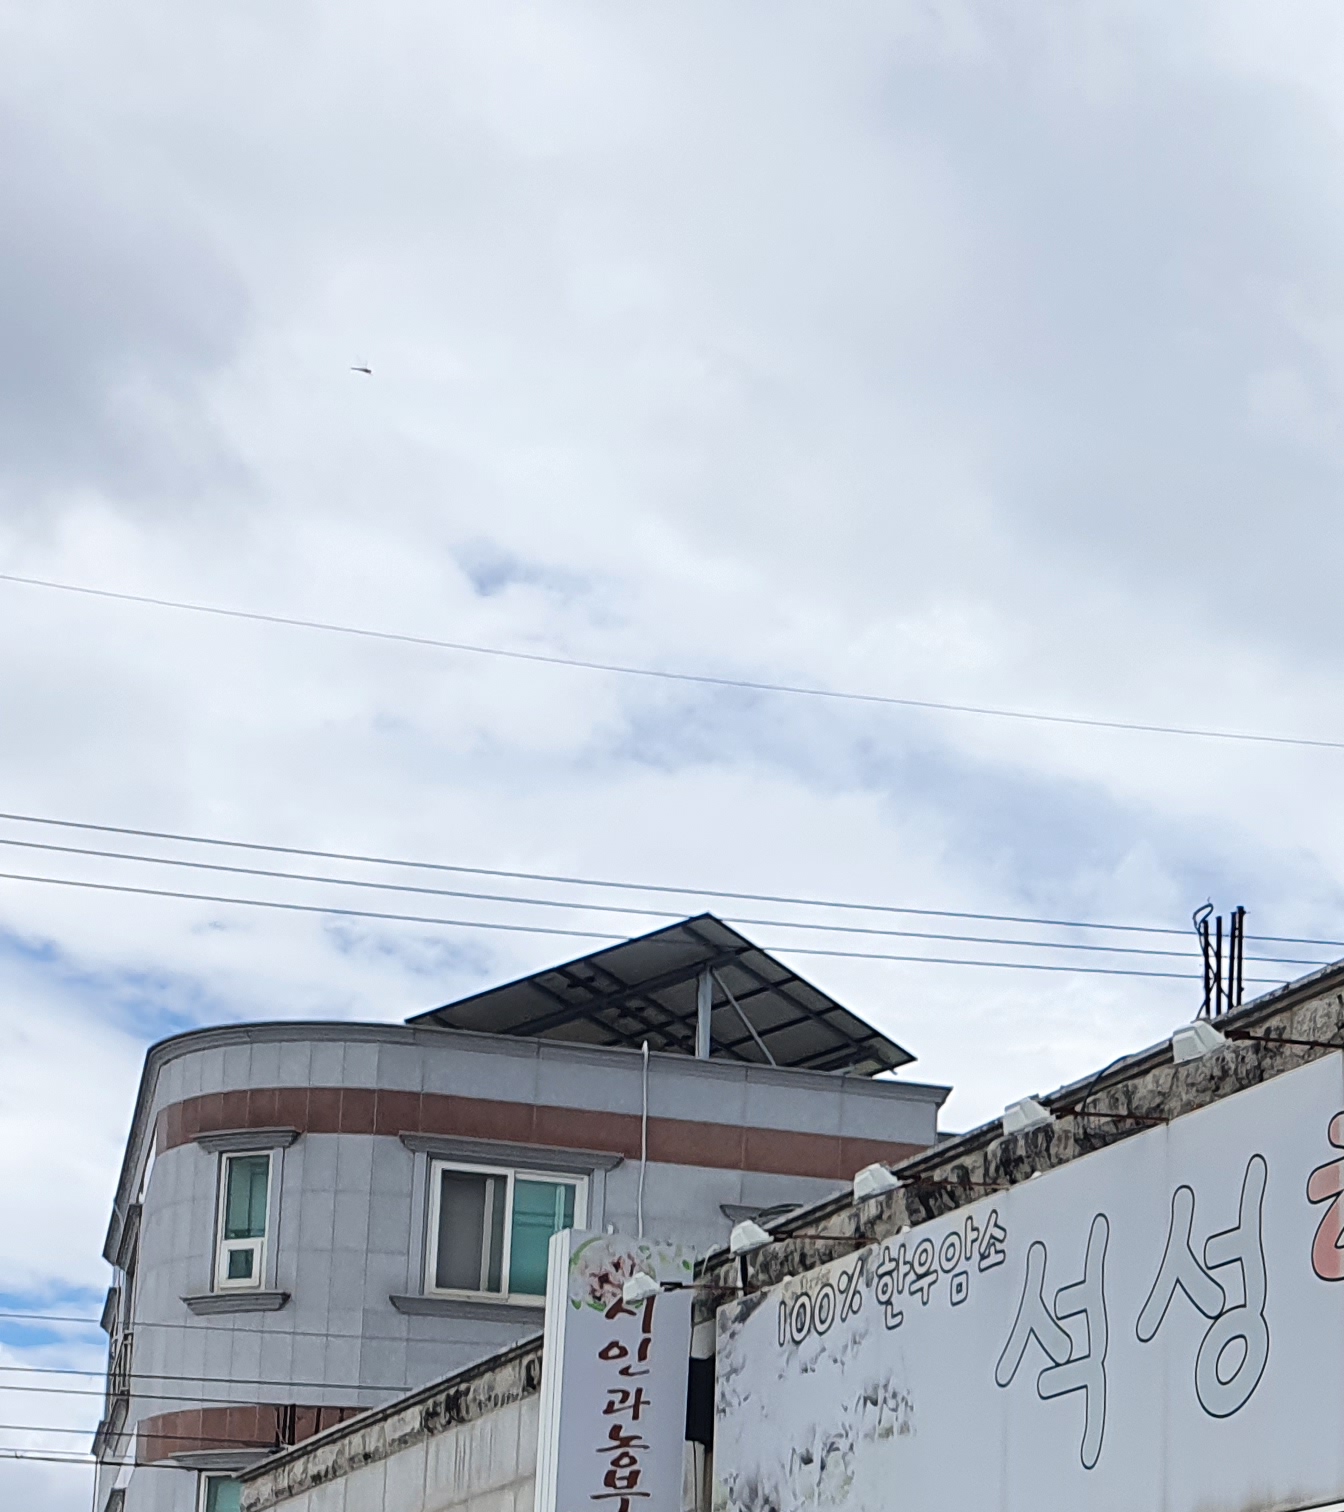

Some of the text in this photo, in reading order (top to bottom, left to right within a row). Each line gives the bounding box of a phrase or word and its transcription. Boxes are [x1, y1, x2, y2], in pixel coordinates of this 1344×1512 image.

[777, 1209, 1007, 1347] 100% 한우암소
[995, 1153, 1269, 1470] 석성
